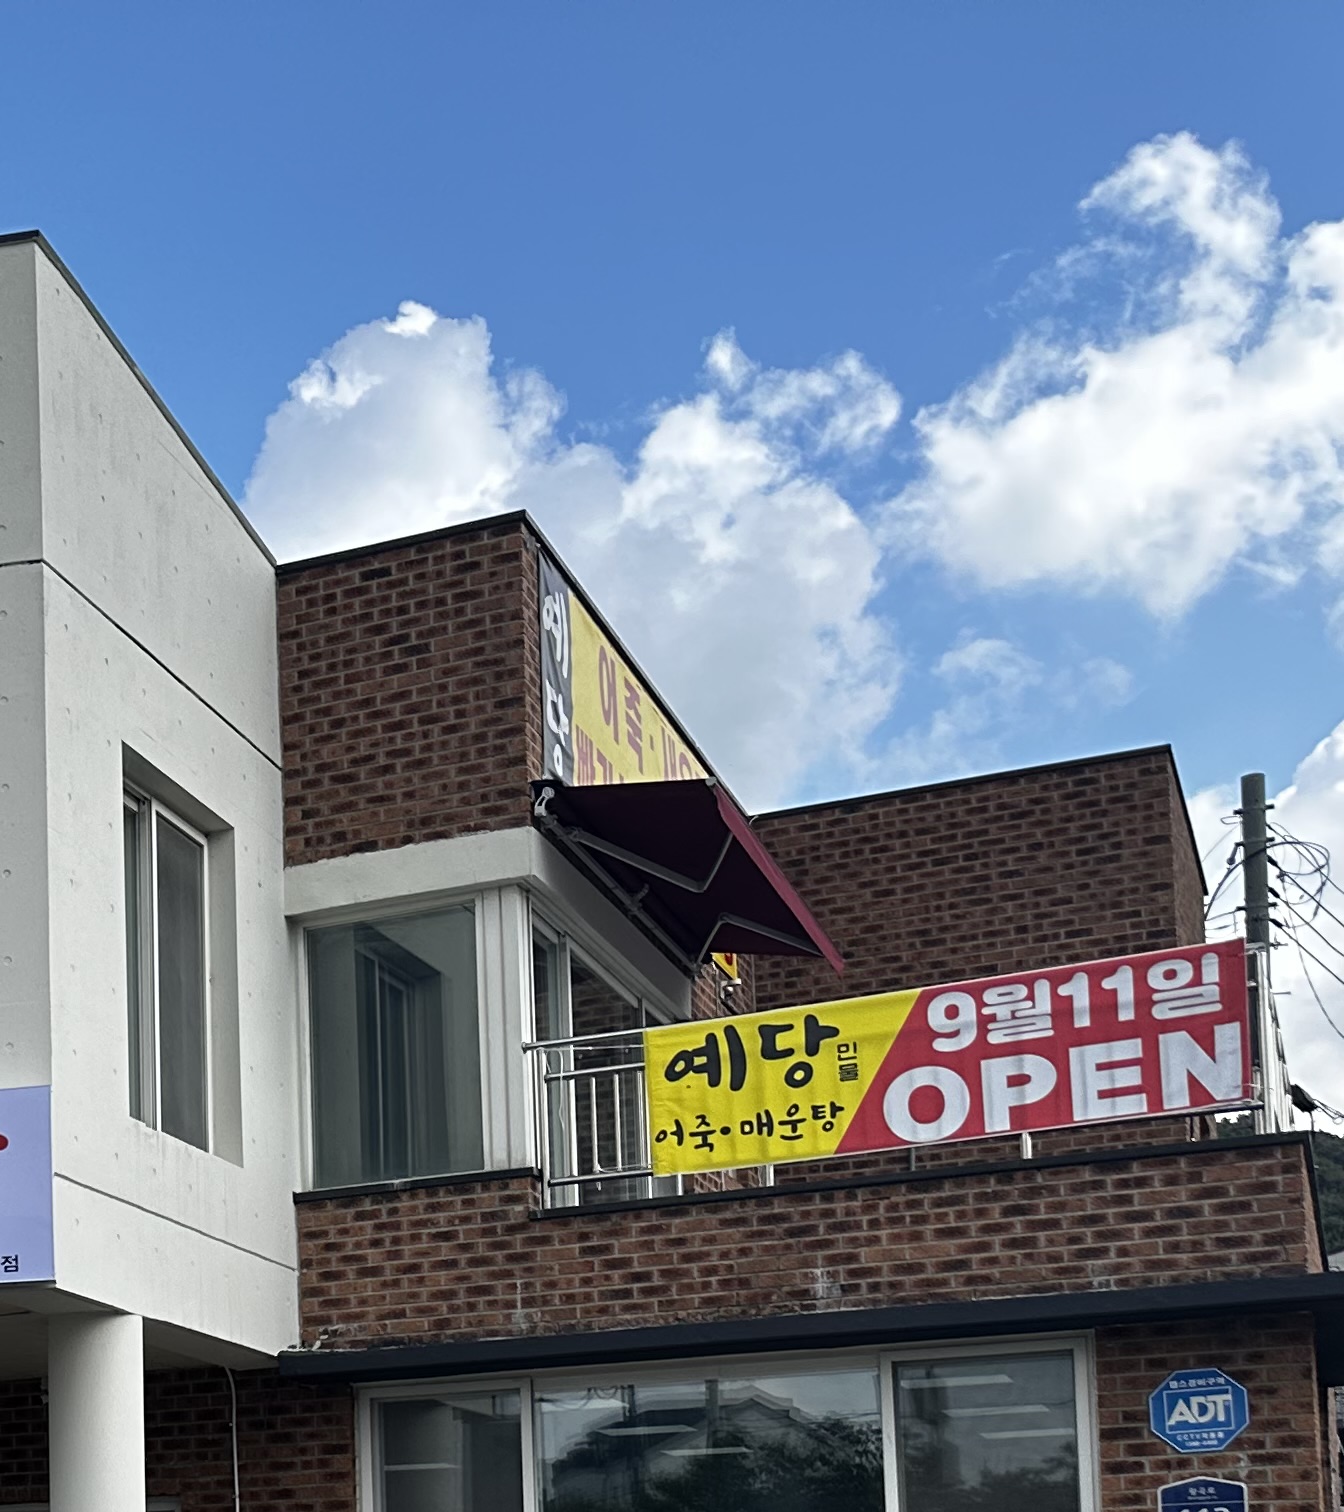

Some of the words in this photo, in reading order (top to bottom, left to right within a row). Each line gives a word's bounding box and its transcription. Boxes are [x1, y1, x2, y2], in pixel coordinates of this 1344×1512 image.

[927, 952, 1223, 1052] 9월11일
[664, 1014, 840, 1092] 예당
[883, 1021, 1243, 1143] OPEN
[1167, 1394, 1232, 1425] ADT
